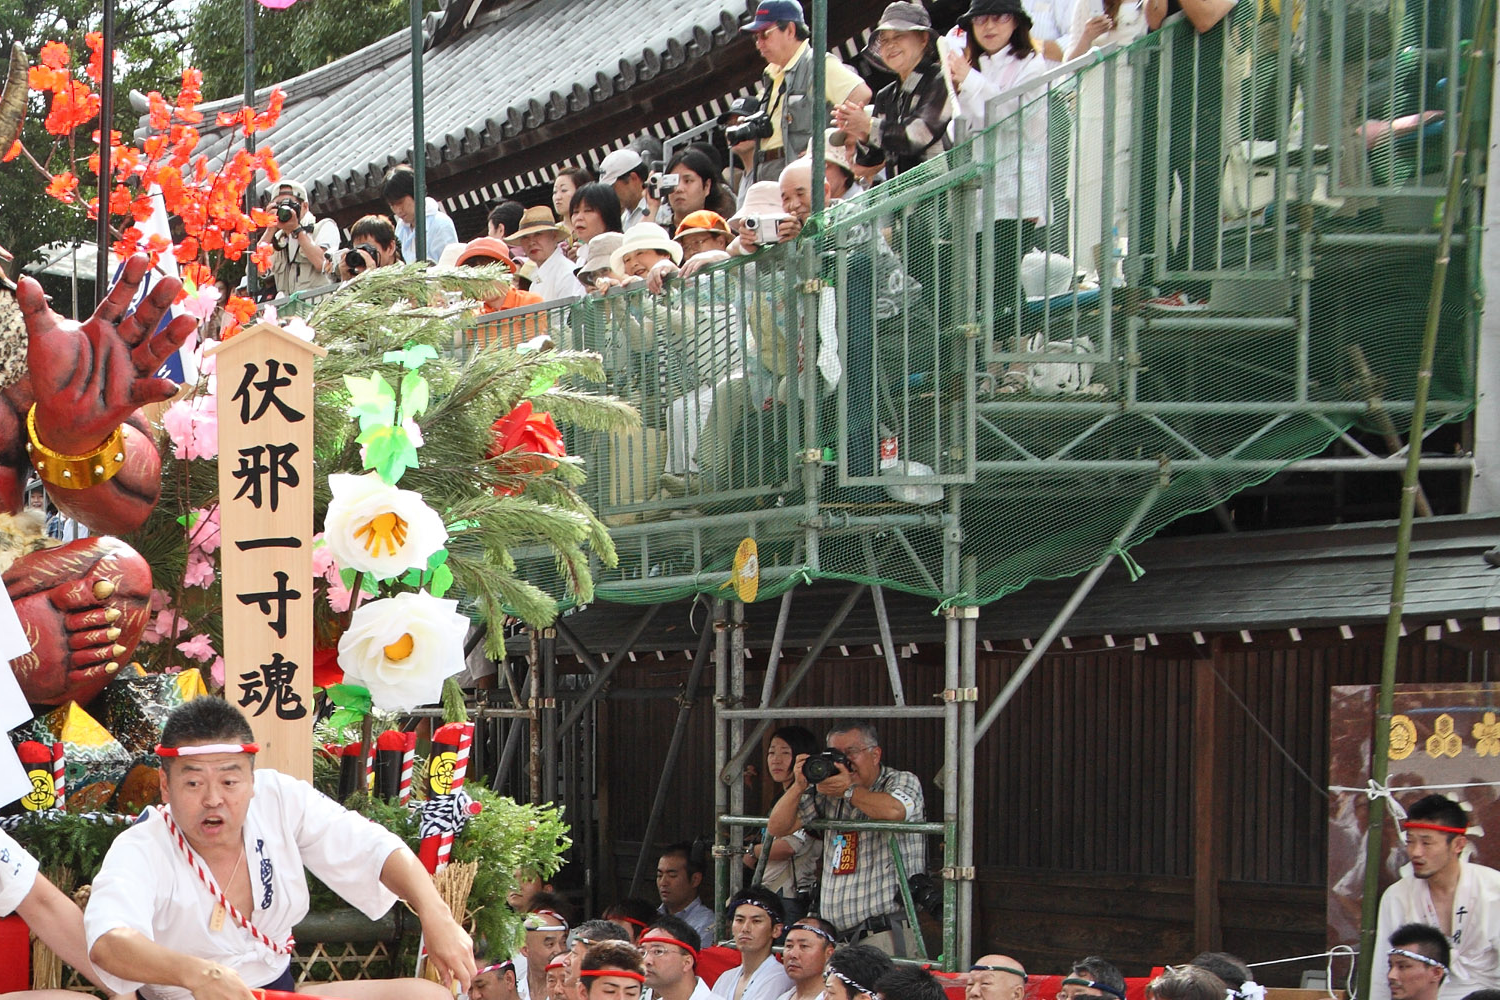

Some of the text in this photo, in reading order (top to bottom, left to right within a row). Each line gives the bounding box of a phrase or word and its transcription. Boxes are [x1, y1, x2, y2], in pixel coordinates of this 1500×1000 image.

[230, 357, 307, 721] 伏邪一寸魂
[841, 834, 852, 870] PRESS
